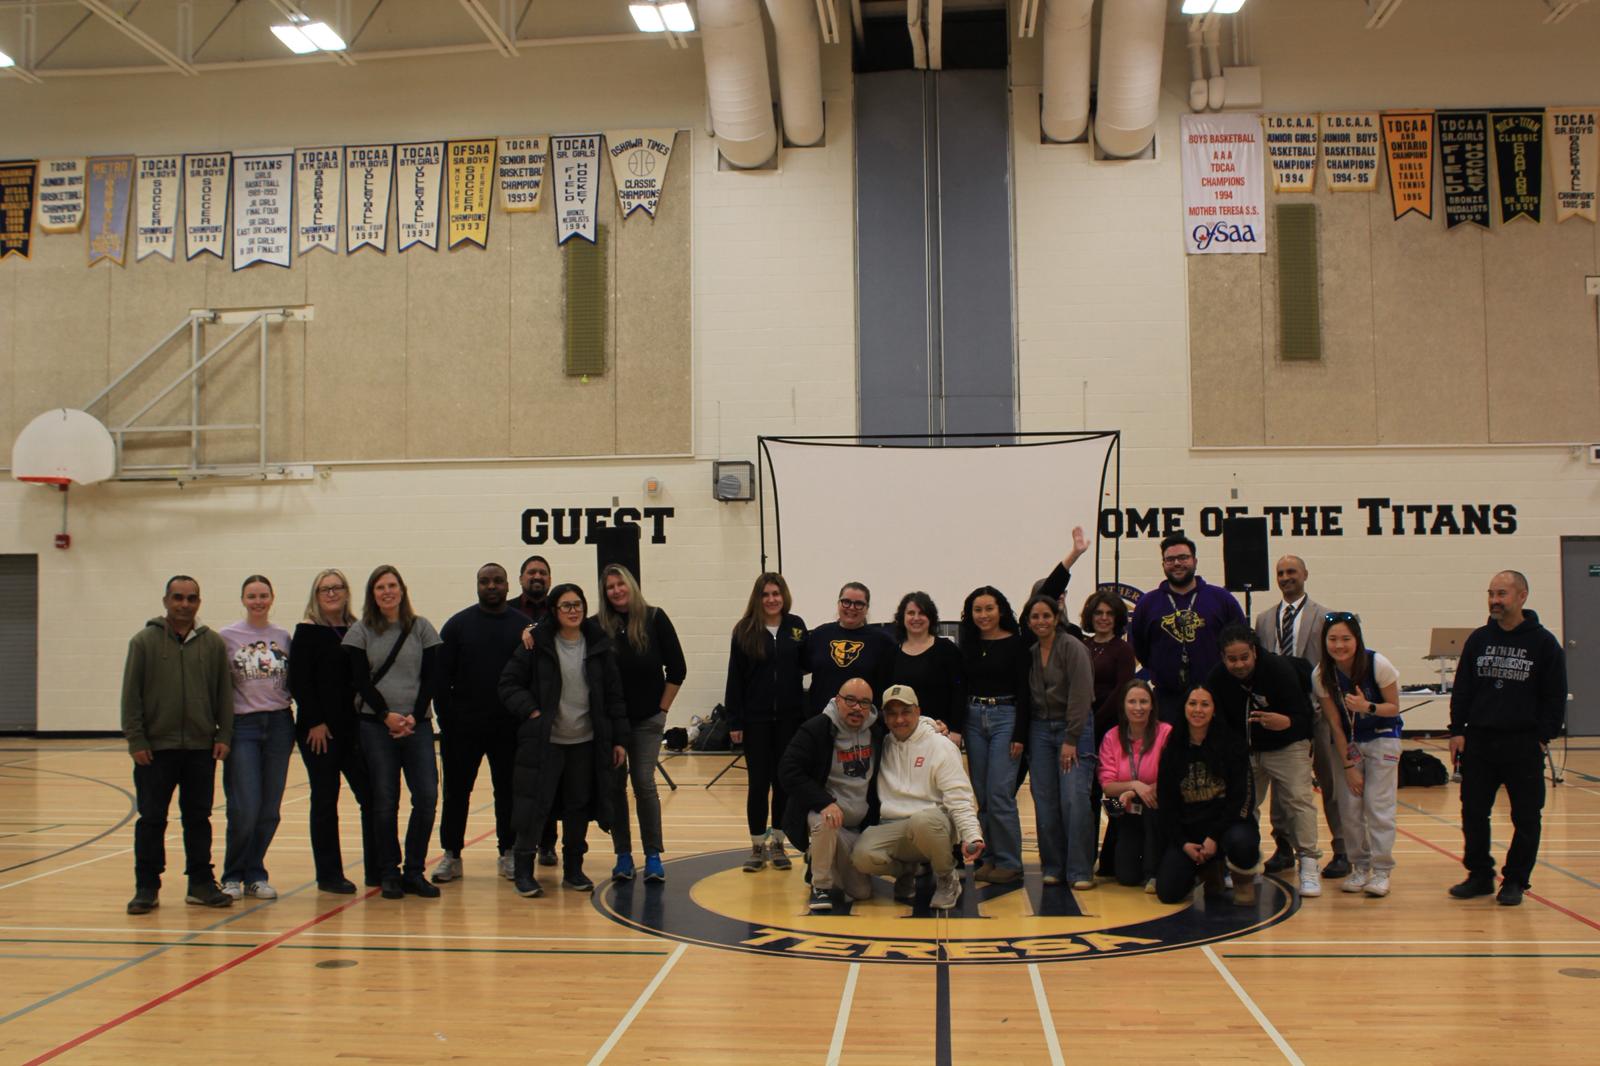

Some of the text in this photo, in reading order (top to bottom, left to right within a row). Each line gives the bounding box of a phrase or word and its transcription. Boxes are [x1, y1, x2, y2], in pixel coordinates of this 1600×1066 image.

[1554, 114, 1594, 126] TDCAA
[1388, 120, 1426, 132] TDCAA
[1441, 120, 1483, 131] TDCAA
[1189, 134, 1254, 144] BOYS BASKETBALL
[1295, 133, 1316, 142] GIRLS
[1323, 133, 1378, 142] JUNIOR BOYS
[454, 144, 490, 156] OFSAA
[506, 141, 539, 150] TDCAA
[556, 140, 594, 150] TDCAA
[611, 138, 670, 157] OSHAWA TIMES
[1392, 141, 1428, 150] ONTARIO
[352, 150, 388, 160] TDCAA
[402, 147, 439, 158] TDCAA
[1325, 146, 1376, 156] BASKETBALL
[302, 152, 337, 162] TDCAA
[500, 154, 546, 164] SENIOR BOYS
[142, 159, 176, 171] TDCAA
[190, 158, 225, 168] TDCAA
[244, 160, 282, 171] TITANS
[1211, 164, 1235, 172] TDCAA
[1327, 160, 1375, 169] CHAMPIONS
[500, 168, 544, 177] BASKETBAL
[1444, 145, 1464, 193] FIELD
[1202, 177, 1245, 186] CHAMPIONS
[1280, 174, 1304, 182] 1994
[246, 180, 279, 188] BASKETBALL
[565, 163, 587, 204] FIELD HOCKEY
[625, 179, 656, 188] CLASSIC
[415, 166, 424, 222] VOLLEYBALL
[464, 166, 474, 212] SOCCER
[364, 168, 374, 224] VOLLEYBALL
[619, 190, 660, 199] CHAMPIONS
[1214, 191, 1232, 200] 1994
[152, 180, 162, 226] SOCCER
[201, 178, 212, 224] SOCCER
[1189, 206, 1259, 216] MOTHER TERESA S.S.
[452, 214, 486, 222] CHAMPIONS
[1264, 506, 1343, 536] THE
[1358, 498, 1517, 535] TITANS
[521, 508, 674, 544] GUEST
[1478, 666, 1530, 682] LEADERSHIP
[740, 928, 1162, 959] TERESA
